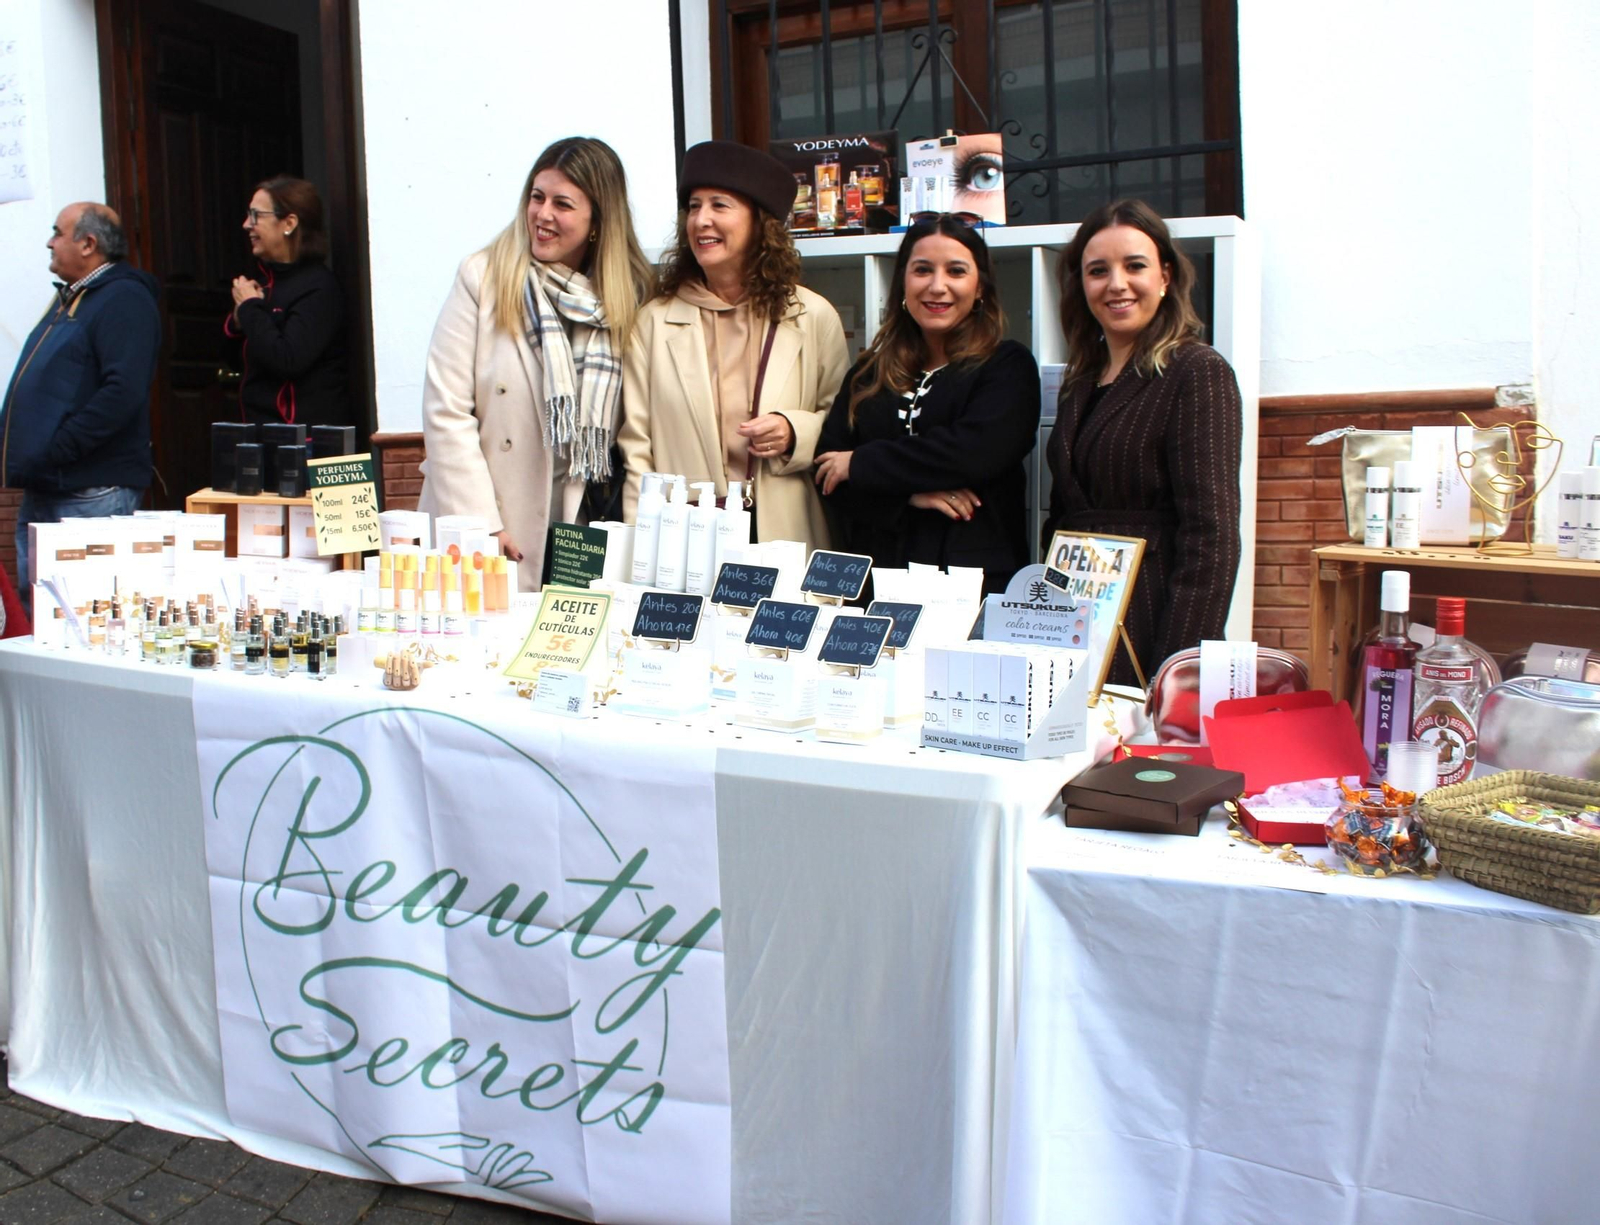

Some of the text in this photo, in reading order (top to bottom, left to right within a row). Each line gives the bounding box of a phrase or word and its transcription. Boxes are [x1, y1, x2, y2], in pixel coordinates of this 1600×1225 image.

[794, 137, 869, 151] YODEYMA
[912, 157, 943, 169] evoeye
[317, 463, 363, 475] PERFUMES
[316, 472, 367, 485] YODEYMA
[322, 494, 369, 507] 100ml 24€
[324, 509, 371, 521] 50ml 15€
[555, 528, 584, 541] RUTINA
[555, 538, 605, 556] FACIAL DIARIA
[812, 554, 837, 573] Antes
[720, 565, 748, 582] Antes
[751, 571, 775, 587] 36€
[804, 574, 857, 592] Ahora 45€
[715, 584, 749, 600] Ahora
[1029, 581, 1050, 603] 美
[1096, 581, 1117, 601] DE
[550, 599, 599, 616] ACEITE
[641, 595, 701, 614] Antes 20€
[1001, 601, 1078, 613] UTSUKUSY
[564, 614, 577, 623] DE
[758, 604, 815, 623] Antes 60€
[1034, 610, 1069, 618] BARCELONA
[538, 621, 596, 636] CUTÍCULAS
[636, 614, 673, 632] Ahora
[834, 618, 885, 634] Antes 40€
[1005, 616, 1070, 634] color creams
[750, 624, 805, 644] Ahora 40€
[824, 634, 858, 651] Ahora
[546, 634, 576, 652] 5€
[524, 651, 581, 665] ENDURECEDORES
[924, 711, 938, 723] DD
[952, 708, 963, 718] EE
[977, 711, 990, 722] CC
[1004, 713, 1017, 724] CC
[1380, 694, 1392, 729] MORA
[924, 734, 939, 744] SKIN
[940, 737, 957, 746] CARE
[961, 740, 981, 749] MAKE
[982, 742, 992, 751] UP
[993, 744, 1019, 755] EFFECT
[1443, 765, 1466, 784] BOSCH
[213, 735, 721, 1034] Beauty
[270, 956, 664, 1133] Secrets
